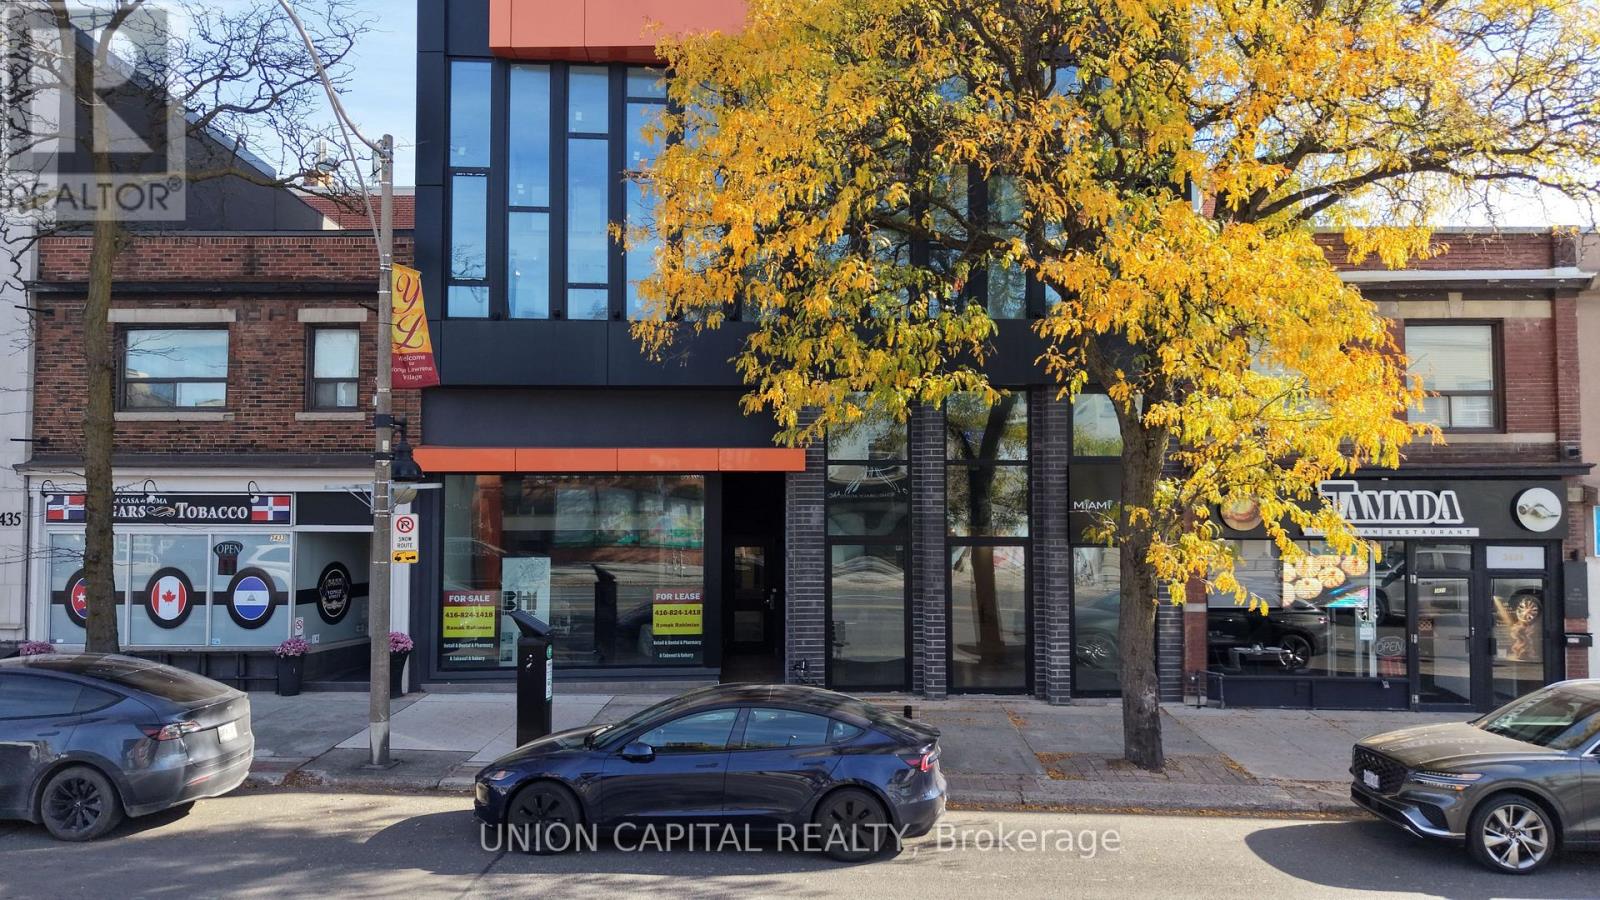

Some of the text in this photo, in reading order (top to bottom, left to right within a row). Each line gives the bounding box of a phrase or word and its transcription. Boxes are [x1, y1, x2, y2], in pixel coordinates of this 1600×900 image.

[1073, 501, 1111, 510] MIAMI
[1318, 481, 1464, 524] TAMADA
[216, 544, 240, 554] OPEN
[448, 595, 466, 603] FOR
[1376, 641, 1403, 652] OPEN
